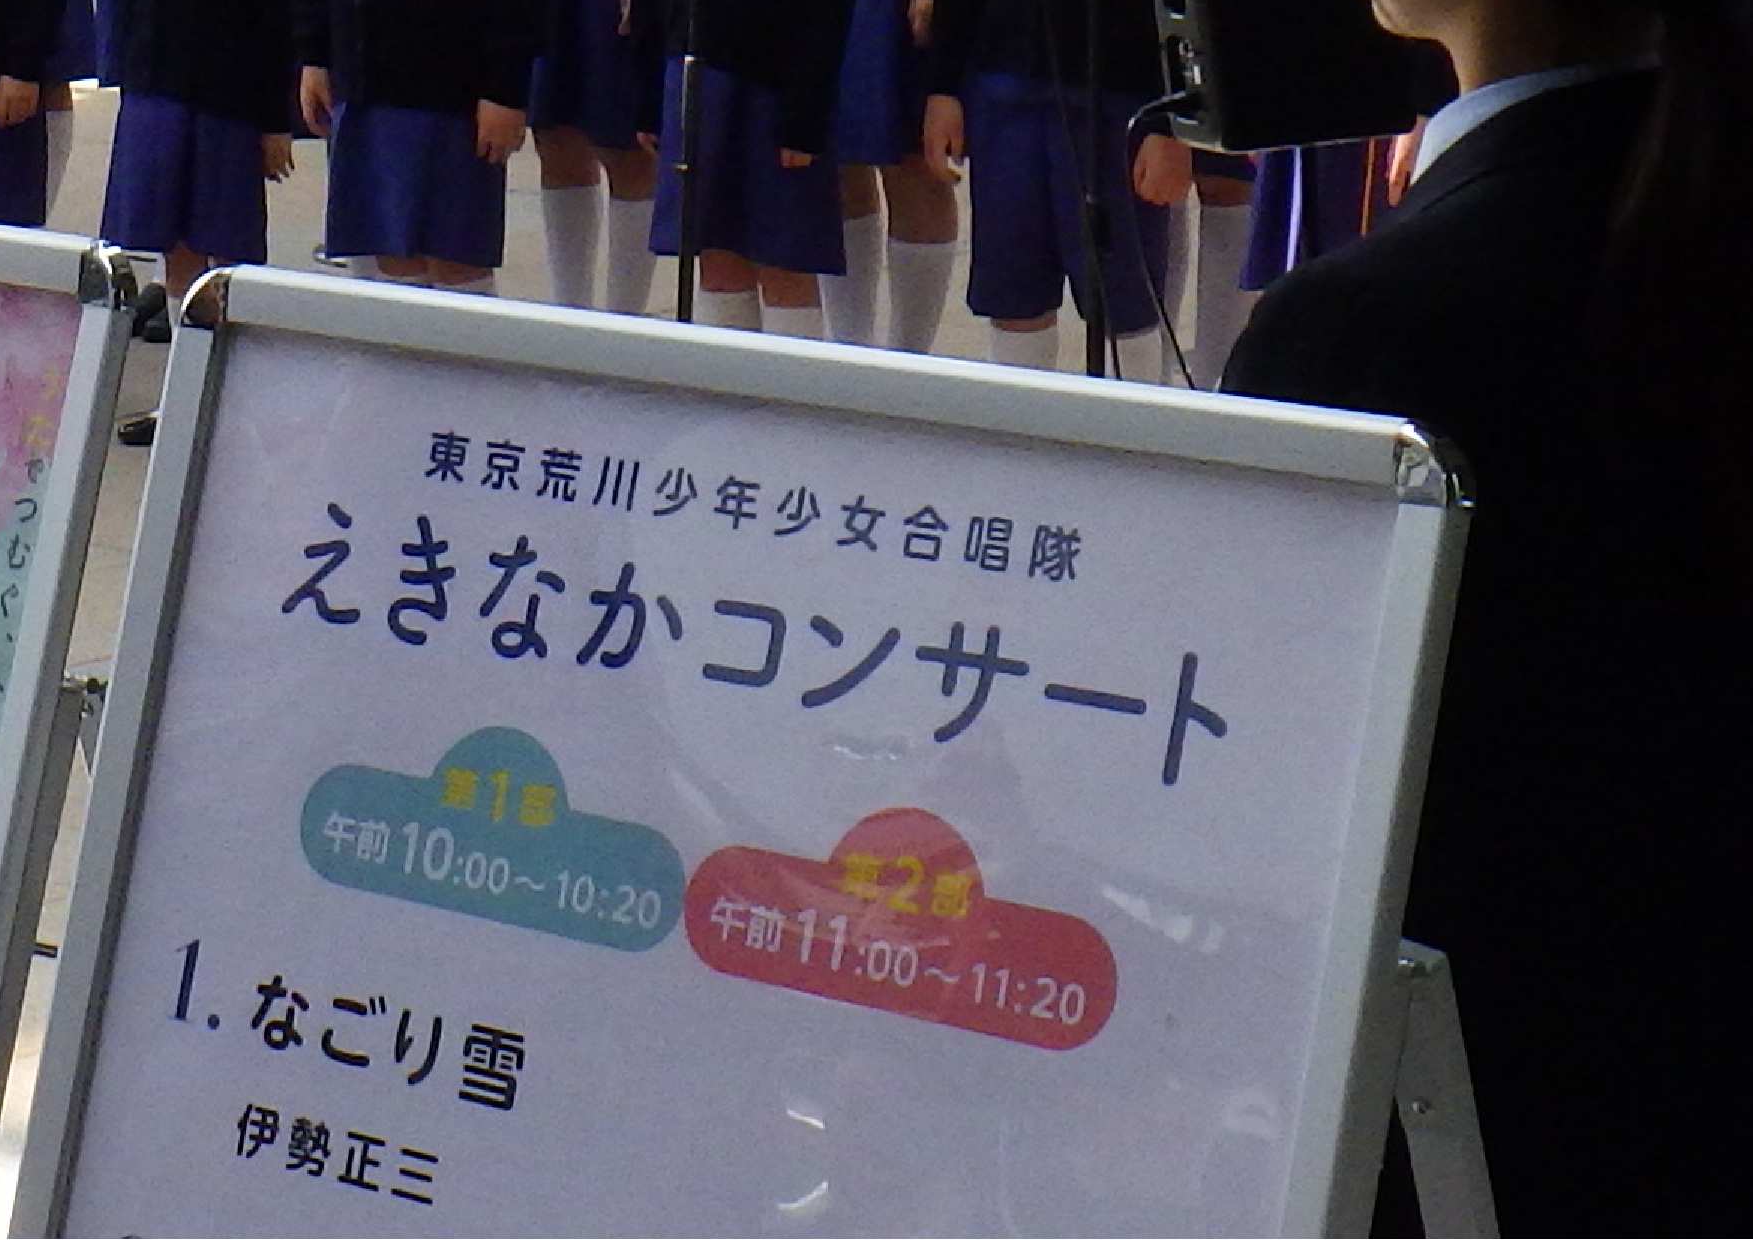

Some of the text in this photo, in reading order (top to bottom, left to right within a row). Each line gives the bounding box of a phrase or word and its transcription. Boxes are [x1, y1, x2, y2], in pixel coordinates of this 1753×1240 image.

[424, 431, 1083, 583] 東京荒川少年少女合唱隊
[280, 503, 1229, 786] えきなかコンサート
[251, 975, 527, 1111] なごり雪
[236, 1103, 439, 1206] 伊勢正三
